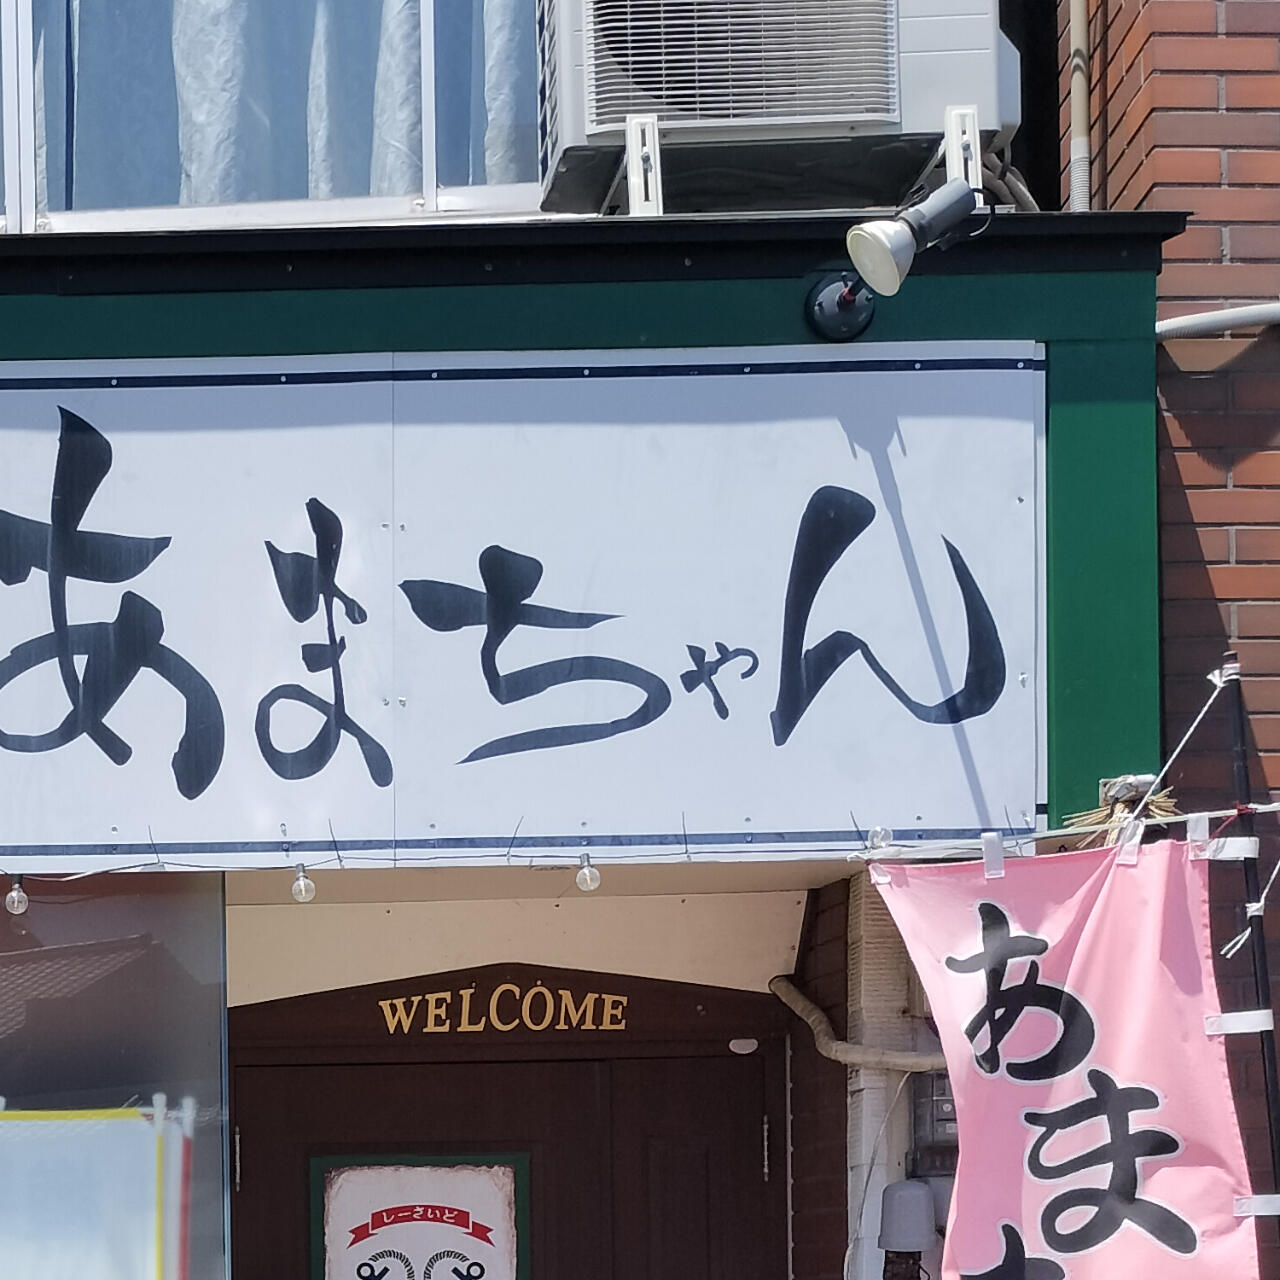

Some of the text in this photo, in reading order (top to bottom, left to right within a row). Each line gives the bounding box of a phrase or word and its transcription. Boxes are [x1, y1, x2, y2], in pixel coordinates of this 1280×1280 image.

[378, 983, 628, 1035] WELCOME
[381, 1206, 459, 1224] しーさいど
